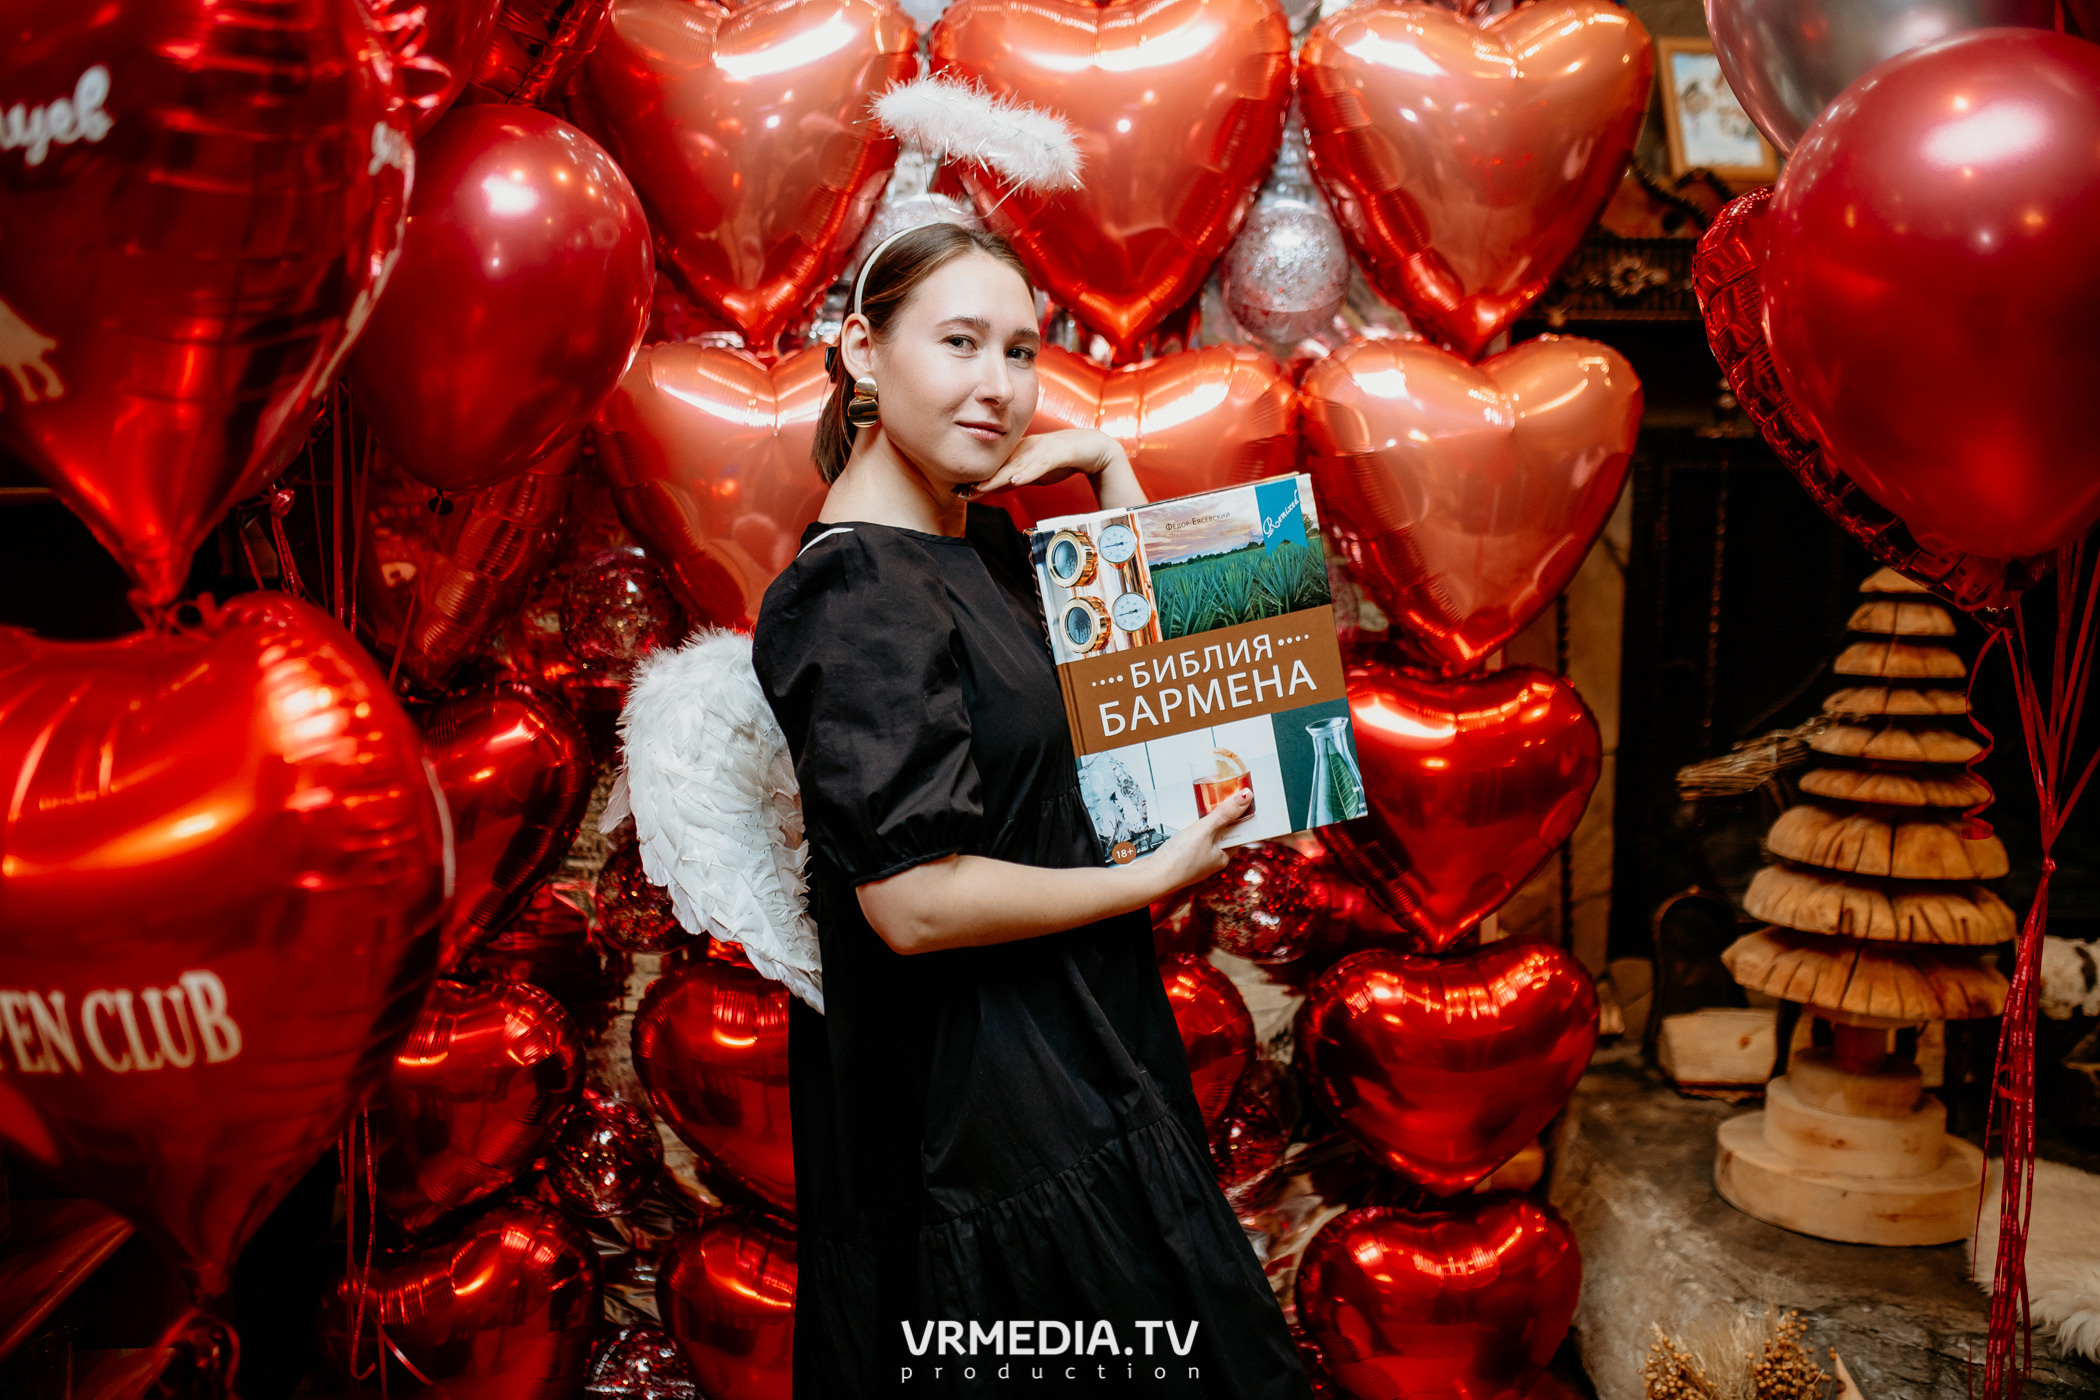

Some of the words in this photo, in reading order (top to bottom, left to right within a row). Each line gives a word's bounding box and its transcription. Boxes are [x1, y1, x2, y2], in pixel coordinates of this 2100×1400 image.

[1262, 489, 1301, 539] Remixed
[1129, 633, 1273, 689] БИБЛИЯ
[1098, 659, 1318, 737] БАРМЕНА
[1115, 847, 1134, 859] 18+
[0, 988, 83, 1074] EN
[81, 968, 243, 1074] CLUB
